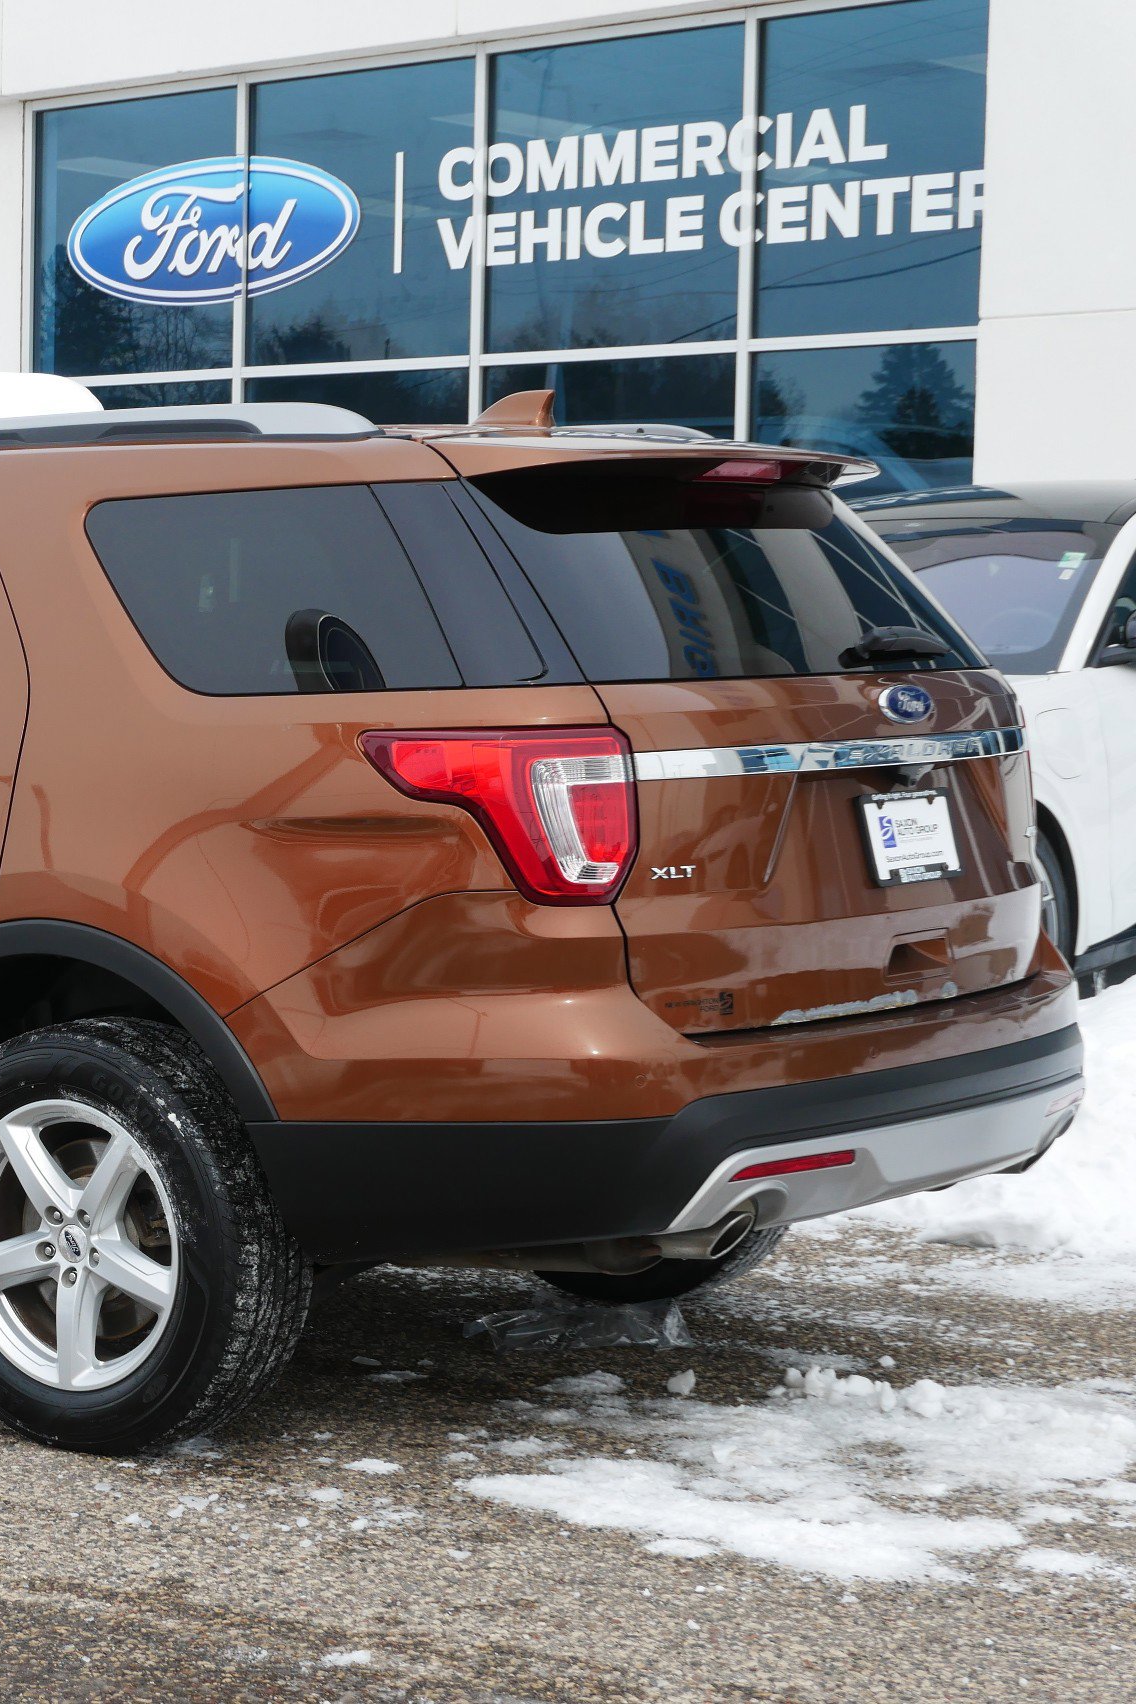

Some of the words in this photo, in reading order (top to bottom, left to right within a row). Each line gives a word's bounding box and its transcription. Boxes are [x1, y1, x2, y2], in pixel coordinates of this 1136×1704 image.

[437, 104, 888, 201] COMMERCIAL
[123, 182, 298, 280] Ford
[437, 194, 705, 270] VEHICLE
[651, 865, 696, 880] XLT
